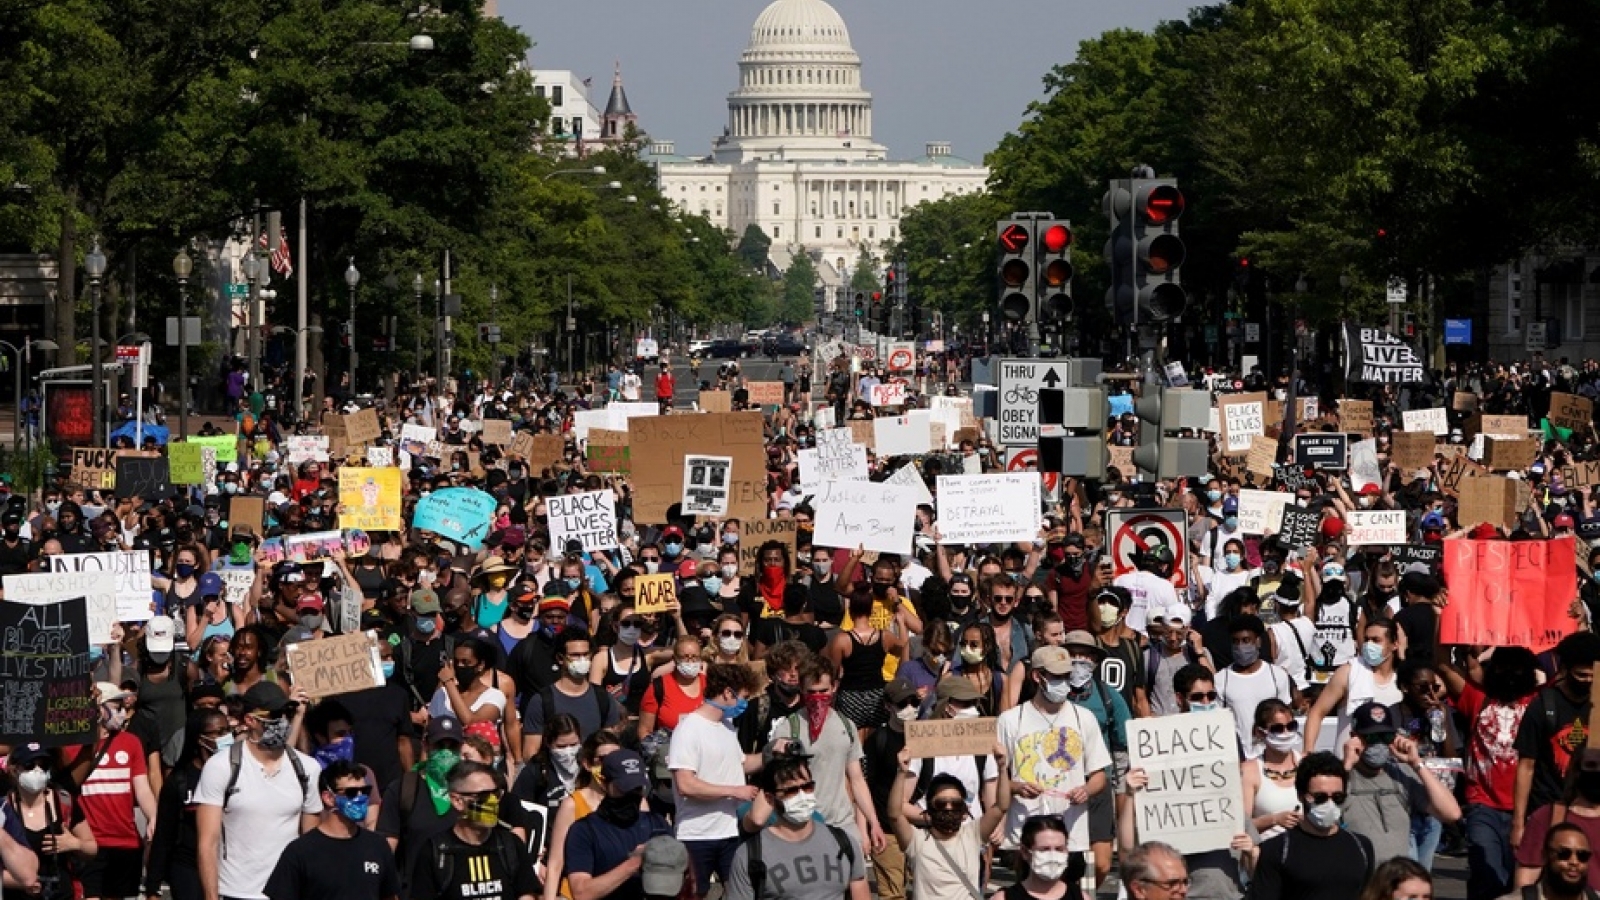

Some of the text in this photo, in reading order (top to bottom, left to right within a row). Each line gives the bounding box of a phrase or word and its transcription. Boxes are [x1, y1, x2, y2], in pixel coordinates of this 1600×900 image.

[1004, 365, 1036, 379] THRU
[1361, 367, 1423, 383] MATTER
[1003, 409, 1034, 423] OBEY
[1228, 417, 1261, 431] LIVES
[634, 420, 702, 443] Black
[1003, 425, 1038, 439] SIGNA
[74, 450, 116, 469] FUCK
[821, 480, 867, 504] Justice
[549, 493, 611, 518] BLACK
[564, 514, 612, 533] LIVES
[745, 520, 764, 536] NO
[557, 529, 616, 551] MTTER
[14, 574, 99, 593] ALLYSHIP
[638, 579, 674, 606] ACAB
[17, 603, 71, 631] ALL
[4, 626, 72, 654] BLACK
[294, 646, 337, 670] BLACK
[314, 660, 373, 689] MATTER
[909, 724, 939, 738] BLACK
[1137, 724, 1225, 759] BLACK
[1145, 760, 1228, 793] LIVES
[1143, 797, 1236, 832] MATTER
[364, 861, 380, 874] PR
[768, 853, 845, 894] PGH
[461, 879, 502, 897] BLACK
